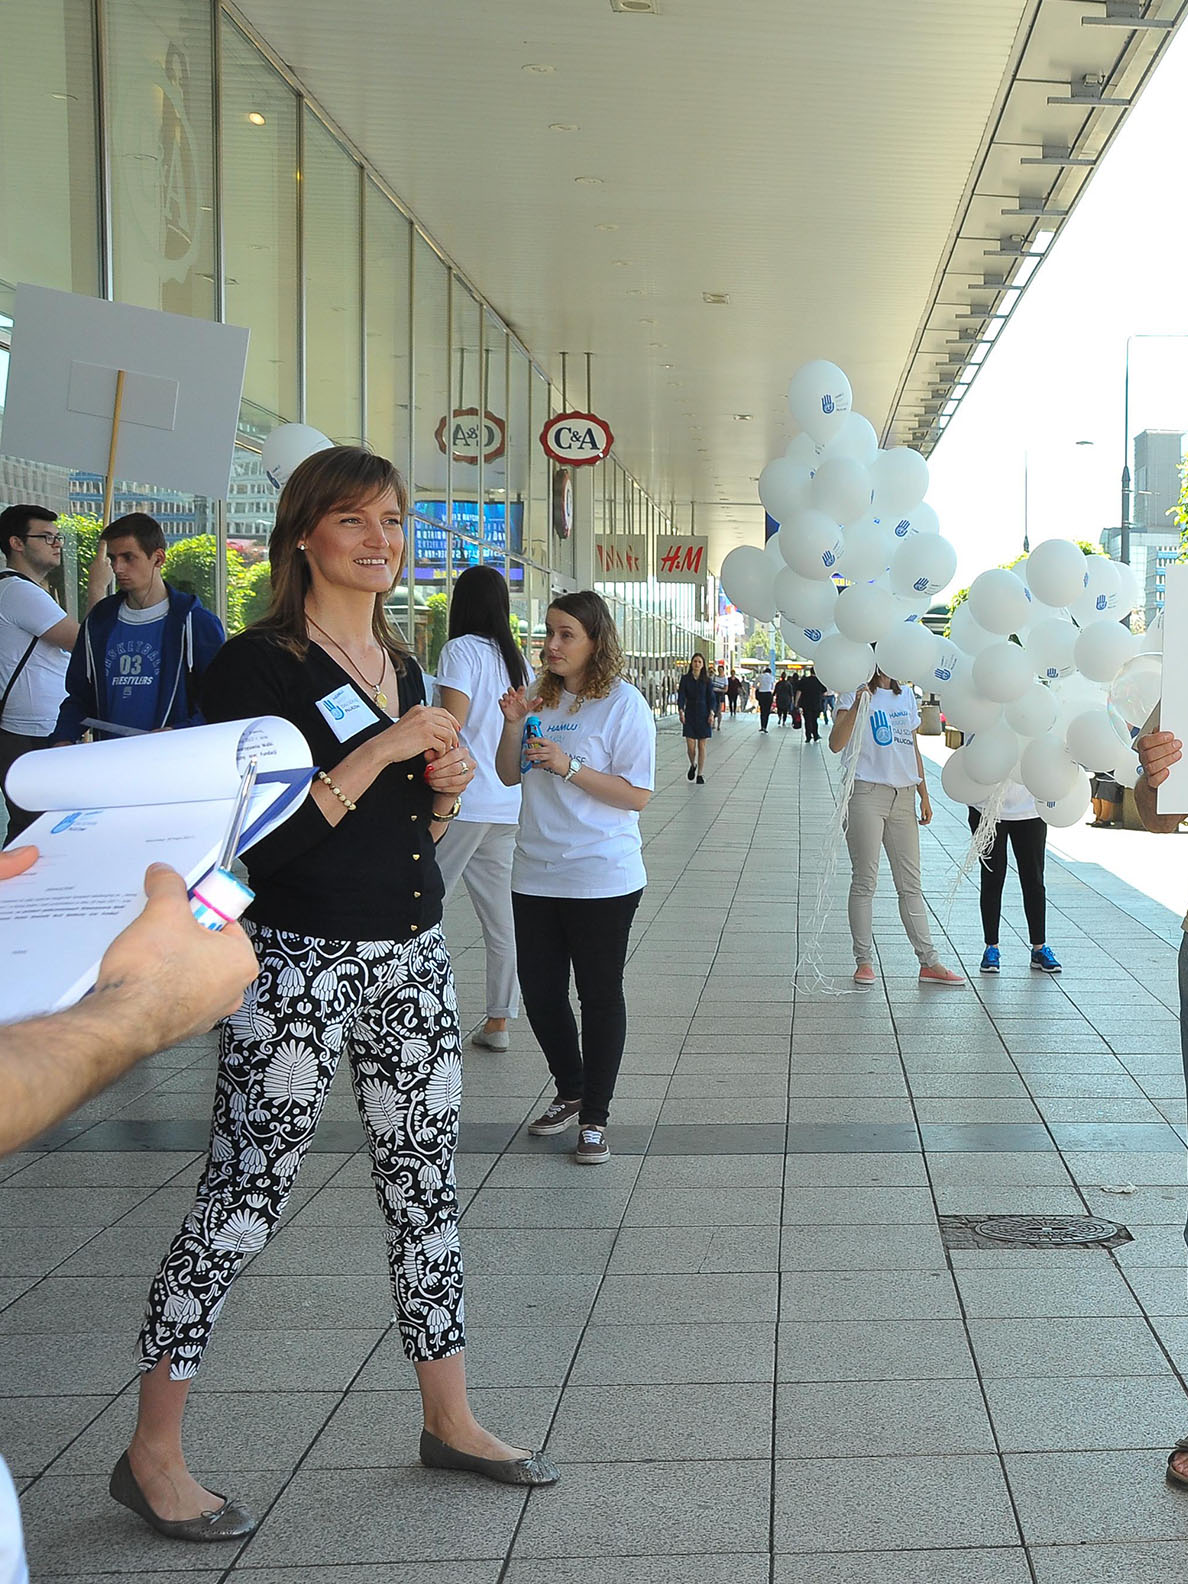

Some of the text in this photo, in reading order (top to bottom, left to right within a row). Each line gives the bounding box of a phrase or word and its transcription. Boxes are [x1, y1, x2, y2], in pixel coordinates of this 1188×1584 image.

[554, 426, 600, 450] C&A
[660, 545, 704, 574] H&M
[120, 655, 142, 675] 03
